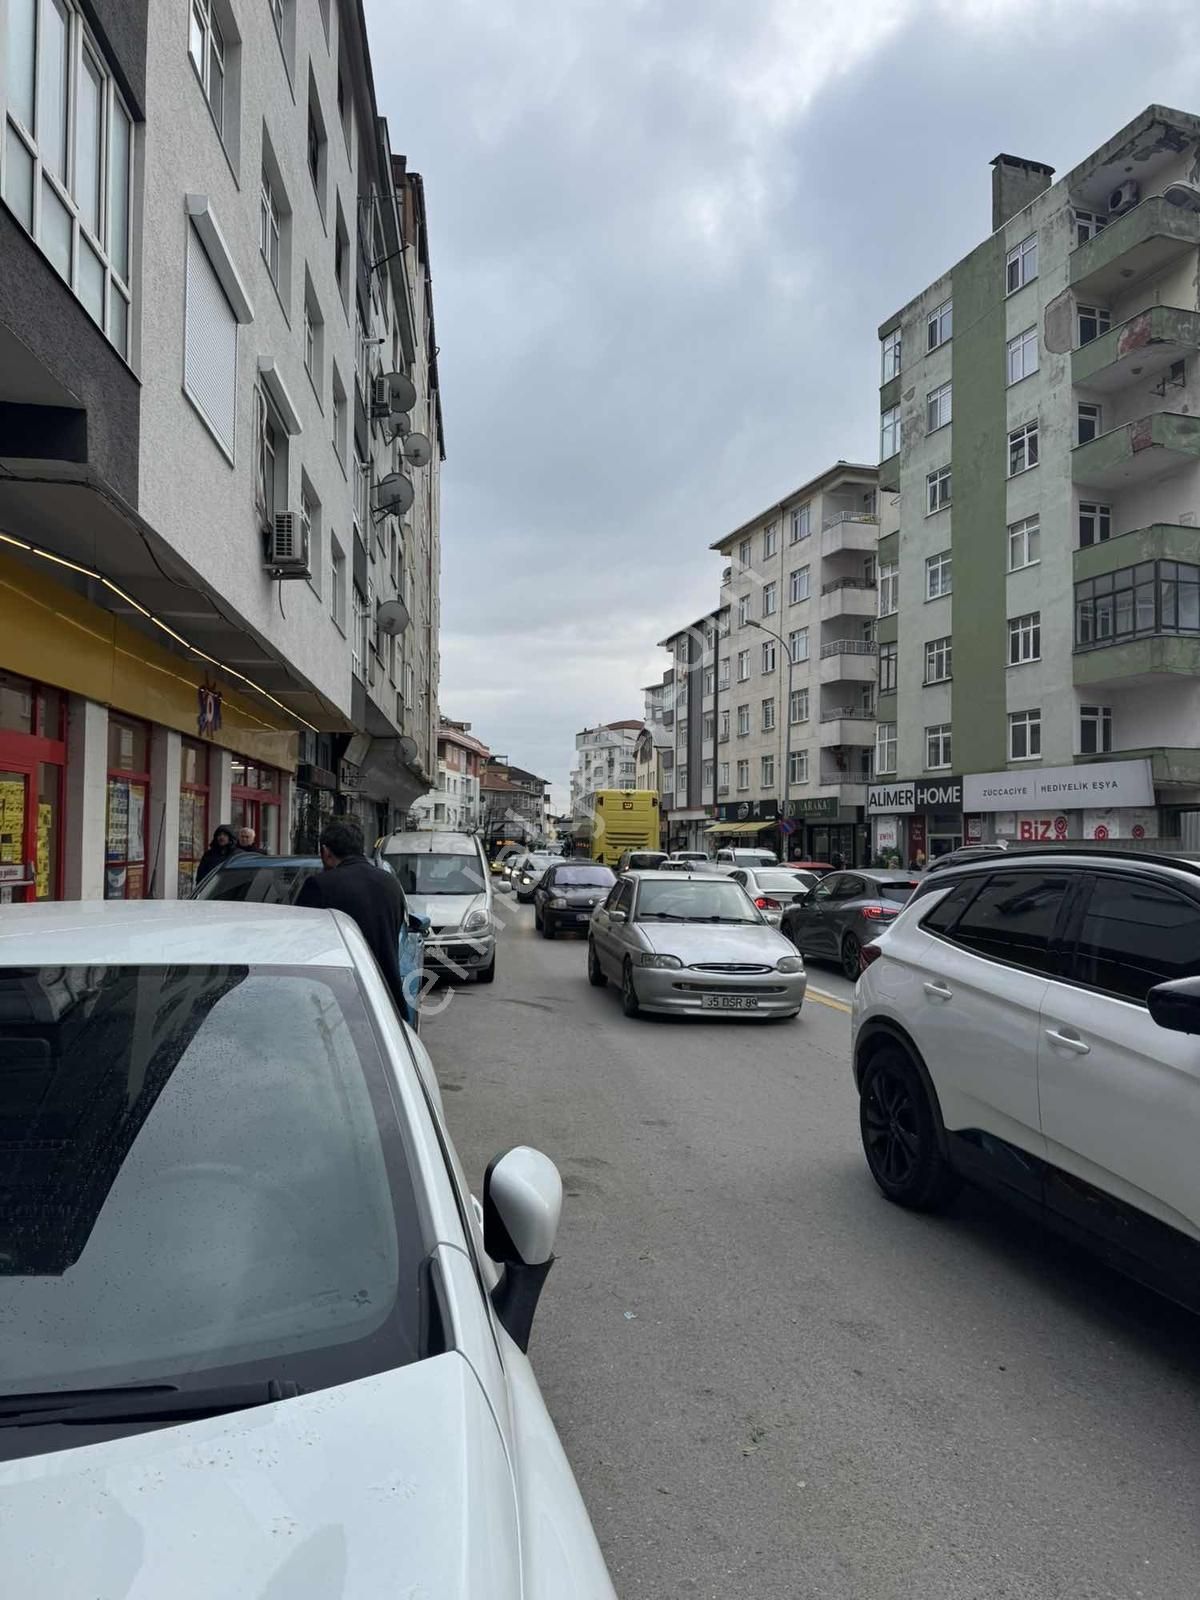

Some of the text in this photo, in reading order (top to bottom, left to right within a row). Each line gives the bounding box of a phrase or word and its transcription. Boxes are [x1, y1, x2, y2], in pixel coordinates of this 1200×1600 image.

[1092, 780, 1118, 791] EŞYA
[870, 786, 960, 807] ALİMER HOME
